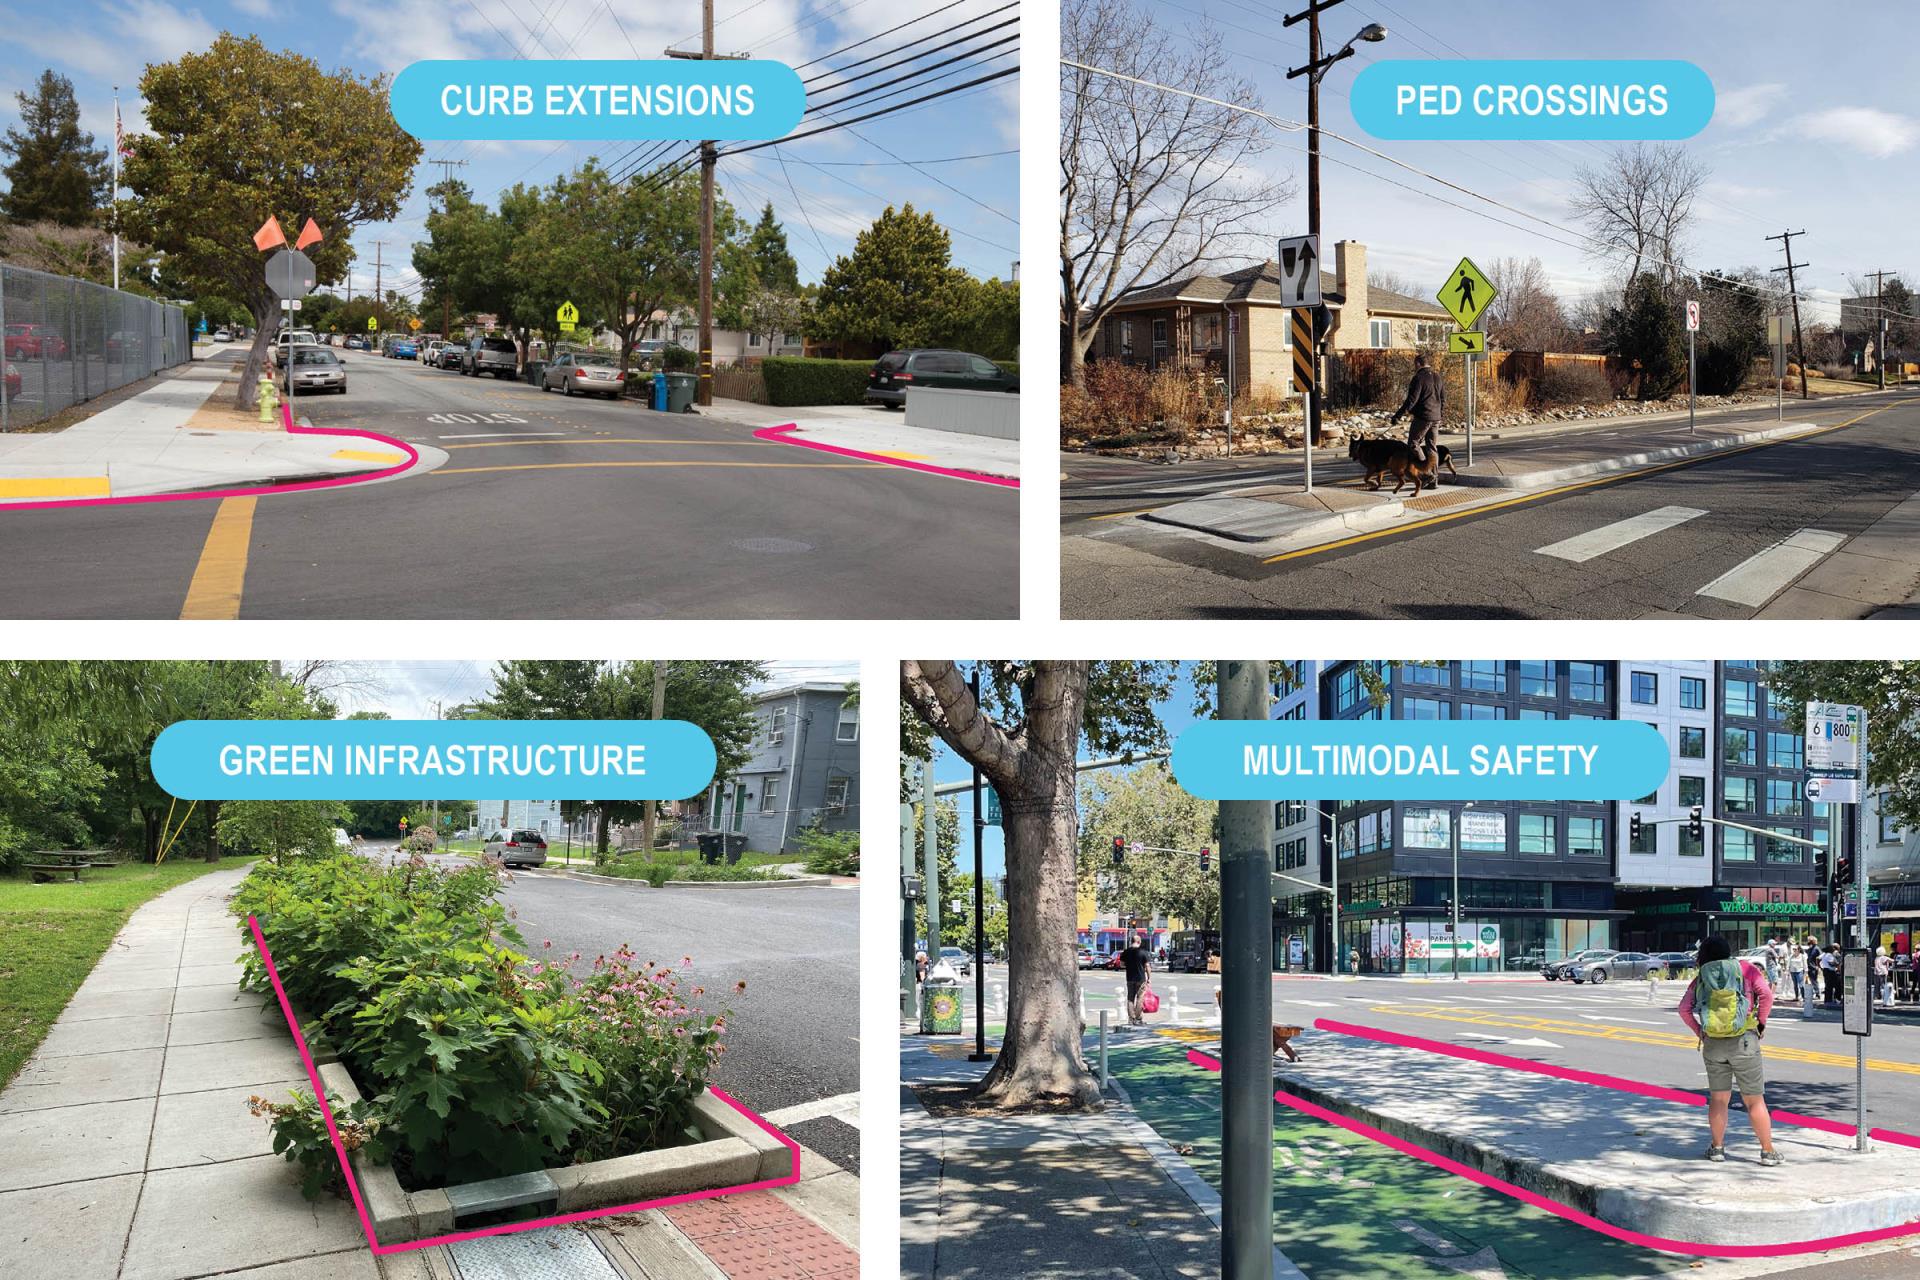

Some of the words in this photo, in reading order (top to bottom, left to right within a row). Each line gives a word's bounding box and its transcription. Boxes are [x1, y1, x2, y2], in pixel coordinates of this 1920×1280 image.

[427, 413, 528, 424] STOP
[1813, 722, 1821, 735] 6
[1833, 723, 1850, 737] 800
[1720, 900, 1760, 913] WHOLE
[1762, 902, 1798, 914] FOODS
